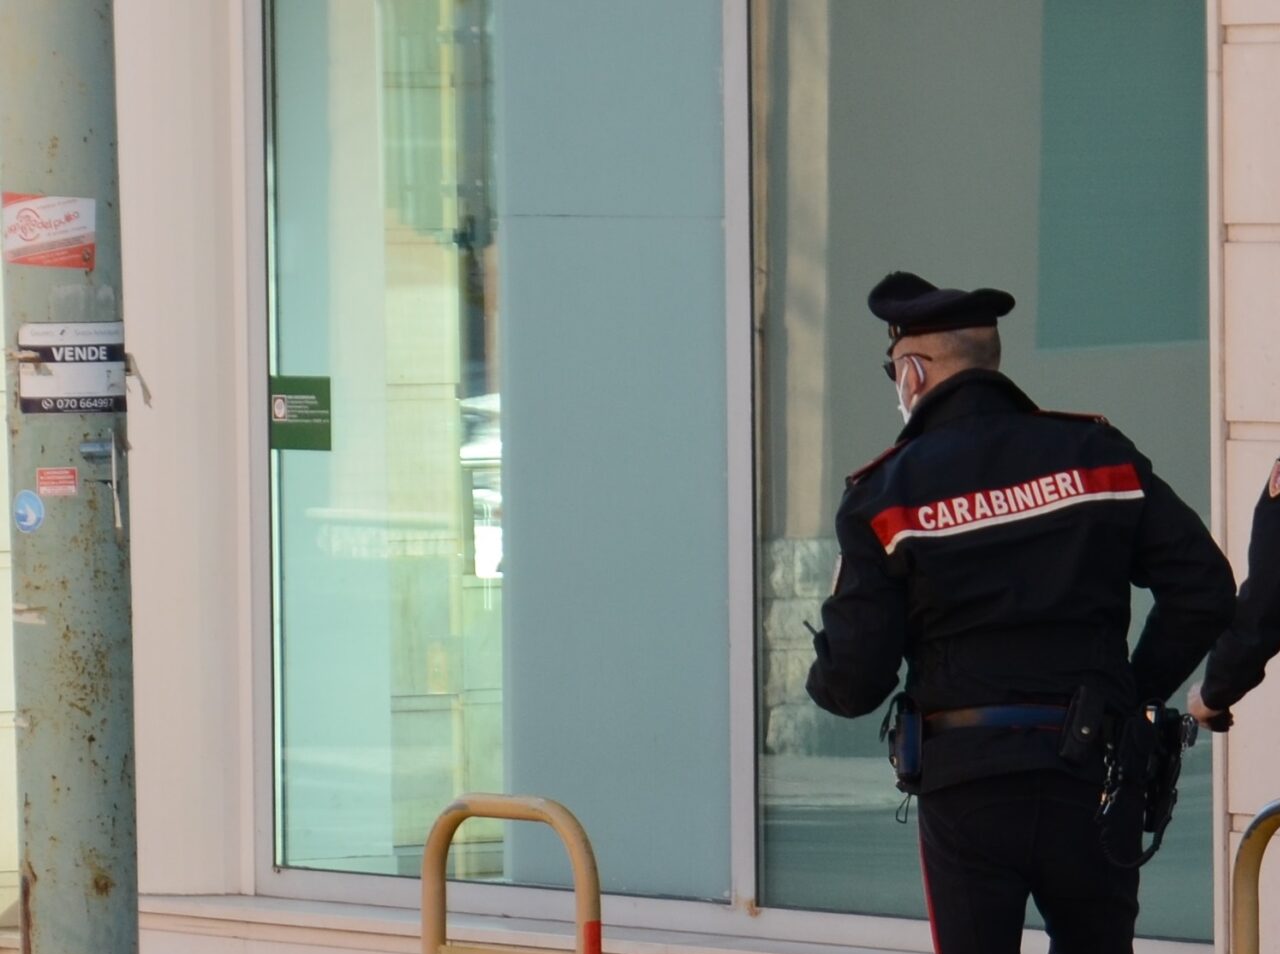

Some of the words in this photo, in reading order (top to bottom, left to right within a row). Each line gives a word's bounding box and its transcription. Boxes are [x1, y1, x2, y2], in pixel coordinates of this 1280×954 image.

[52, 346, 108, 361] VENDE
[56, 398, 77, 409] 070
[917, 469, 1085, 530] CARABINIERI
